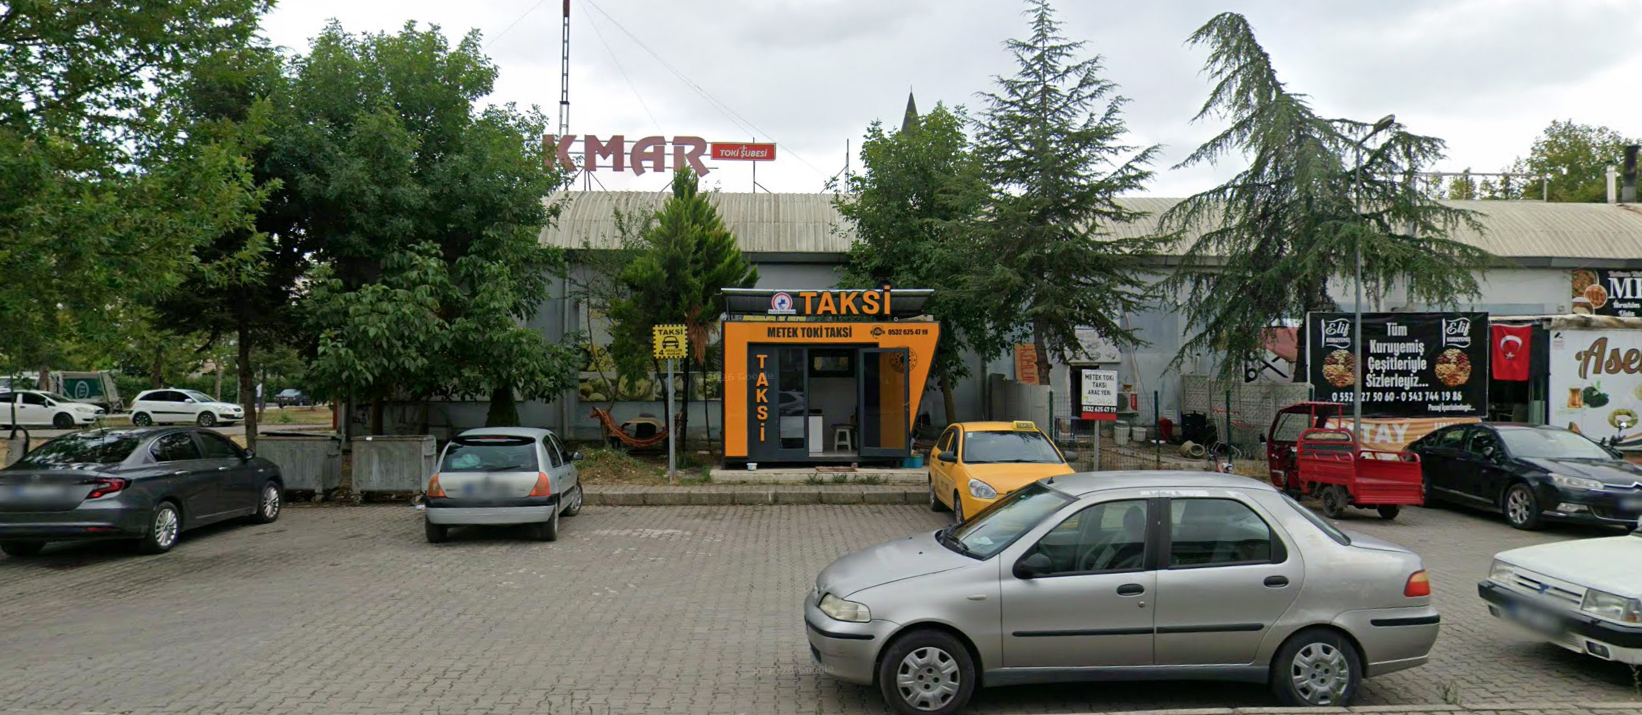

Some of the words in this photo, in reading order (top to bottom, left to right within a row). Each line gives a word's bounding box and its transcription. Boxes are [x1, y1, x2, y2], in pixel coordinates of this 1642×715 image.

[740, 148, 768, 160] ŞUBESİ
[800, 286, 890, 315] TAKSİ
[767, 327, 798, 338] METEK
[801, 324, 823, 338] TOKİ
[824, 324, 852, 338] TAKSİ
[1326, 321, 1350, 337] Elif
[1386, 322, 1407, 336] Tüm
[1446, 321, 1471, 336] Elif
[1369, 339, 1424, 356] Kuruyemiş
[1368, 356, 1427, 373] Çeşitleriyle
[1366, 373, 1429, 390] Sizlerleyiz...
[756, 355, 769, 441] TAKSİ
[1332, 392, 1337, 401] 0
[1339, 392, 1354, 401] 552
[1373, 392, 1382, 401] 50
[1384, 392, 1395, 401] 60
[1401, 392, 1406, 401] 0
[1408, 392, 1423, 401] 543
[1425, 391, 1439, 401] 744
[1441, 391, 1450, 401] 19
[1452, 391, 1462, 401] 86
